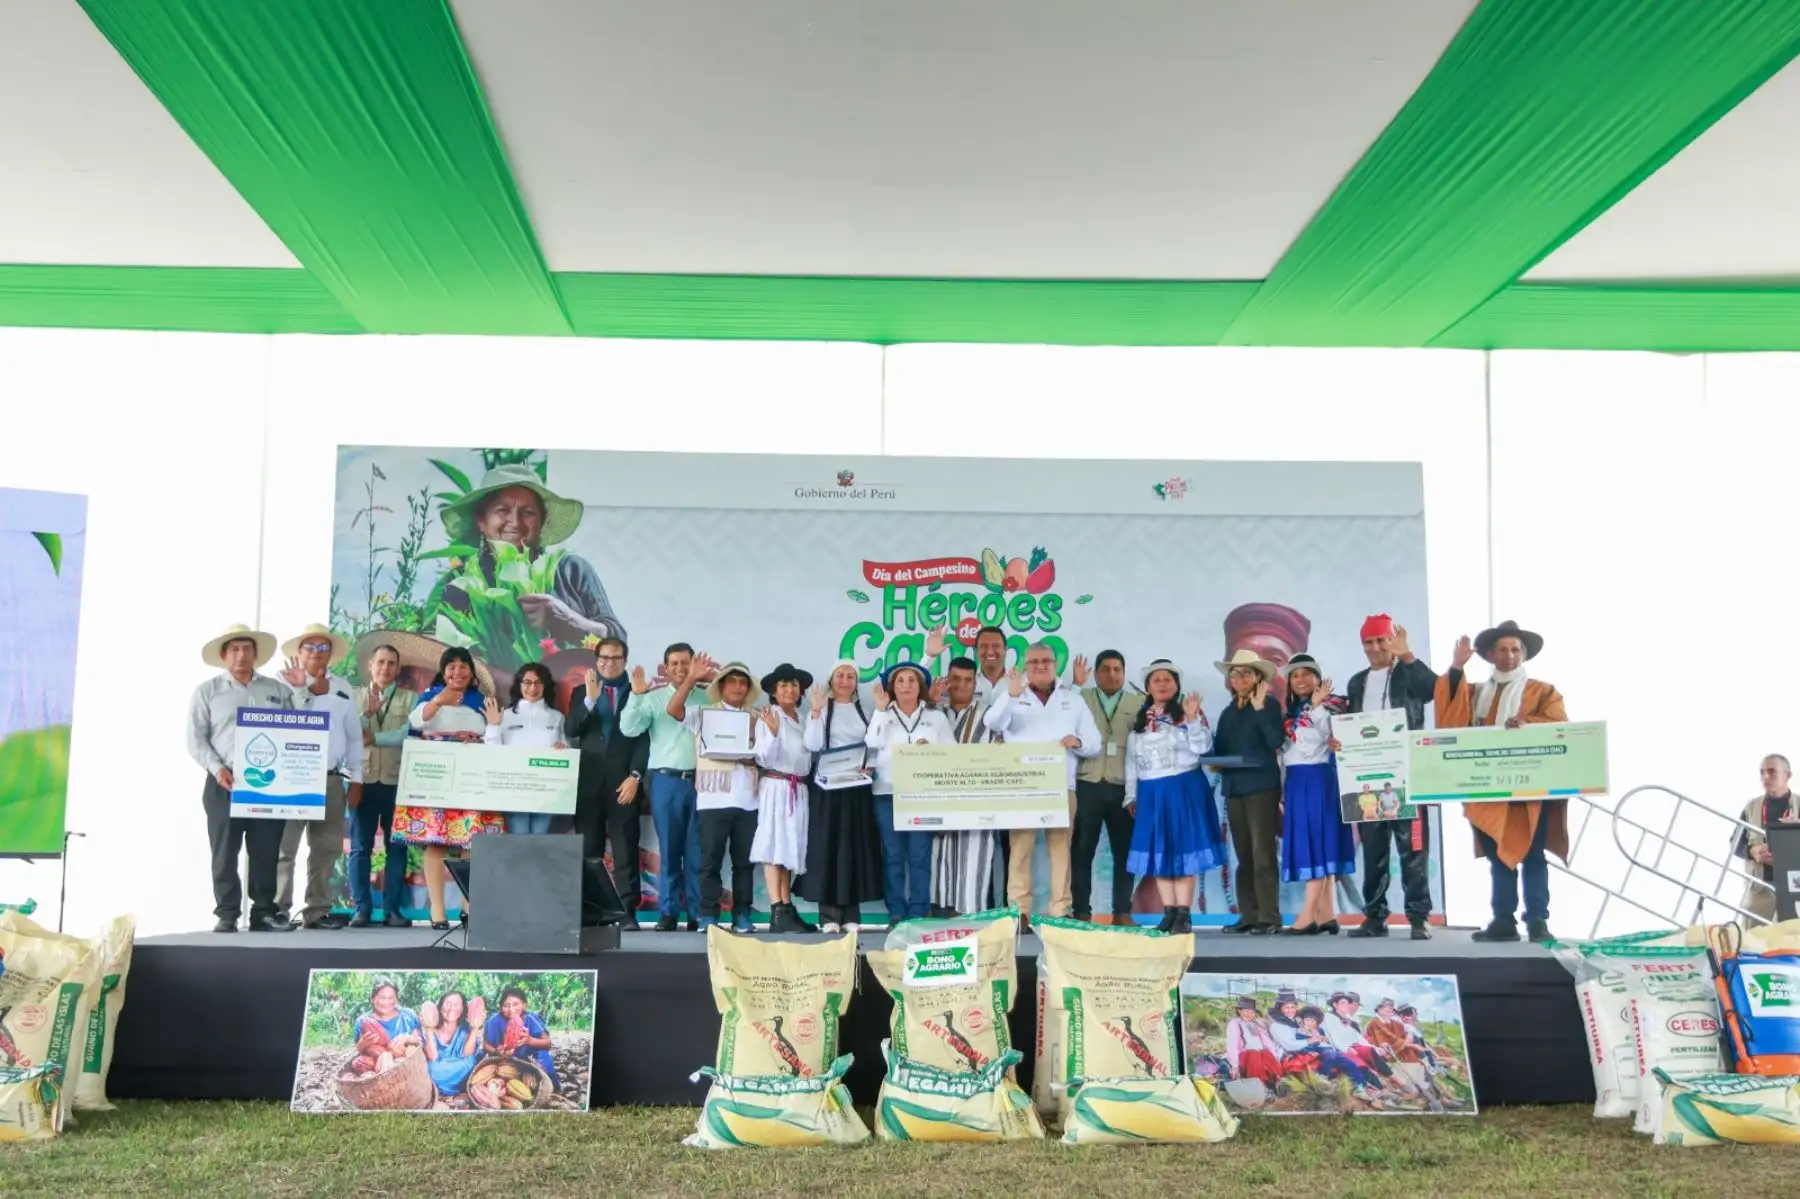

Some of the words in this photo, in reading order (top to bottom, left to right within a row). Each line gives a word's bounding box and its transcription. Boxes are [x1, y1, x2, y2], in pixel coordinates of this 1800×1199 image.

[794, 488, 847, 499] Gobierno
[850, 488, 867, 499] del
[870, 488, 896, 500] Perú
[894, 568, 912, 582] del
[914, 562, 976, 580] Campesino
[883, 581, 1063, 632] Héroes
[242, 712, 274, 722] DERECHO
[274, 714, 283, 723] DE
[284, 714, 297, 724] USO
[298, 715, 306, 724] DE
[306, 716, 324, 725] AGUA
[920, 962, 961, 972] AGRARIO
[926, 955, 955, 964] BONO
[1632, 964, 1696, 972] FERTI
[59, 992, 71, 1017] ISLAS
[54, 1018, 65, 1035] LAS
[1583, 991, 1604, 1066] FERTIUREA
[1671, 1020, 1718, 1031] CERES
[52, 1036, 61, 1048] DE
[1630, 999, 1646, 1077] FERTIUREA
[1101, 1021, 1168, 1077] ARTESANAL
